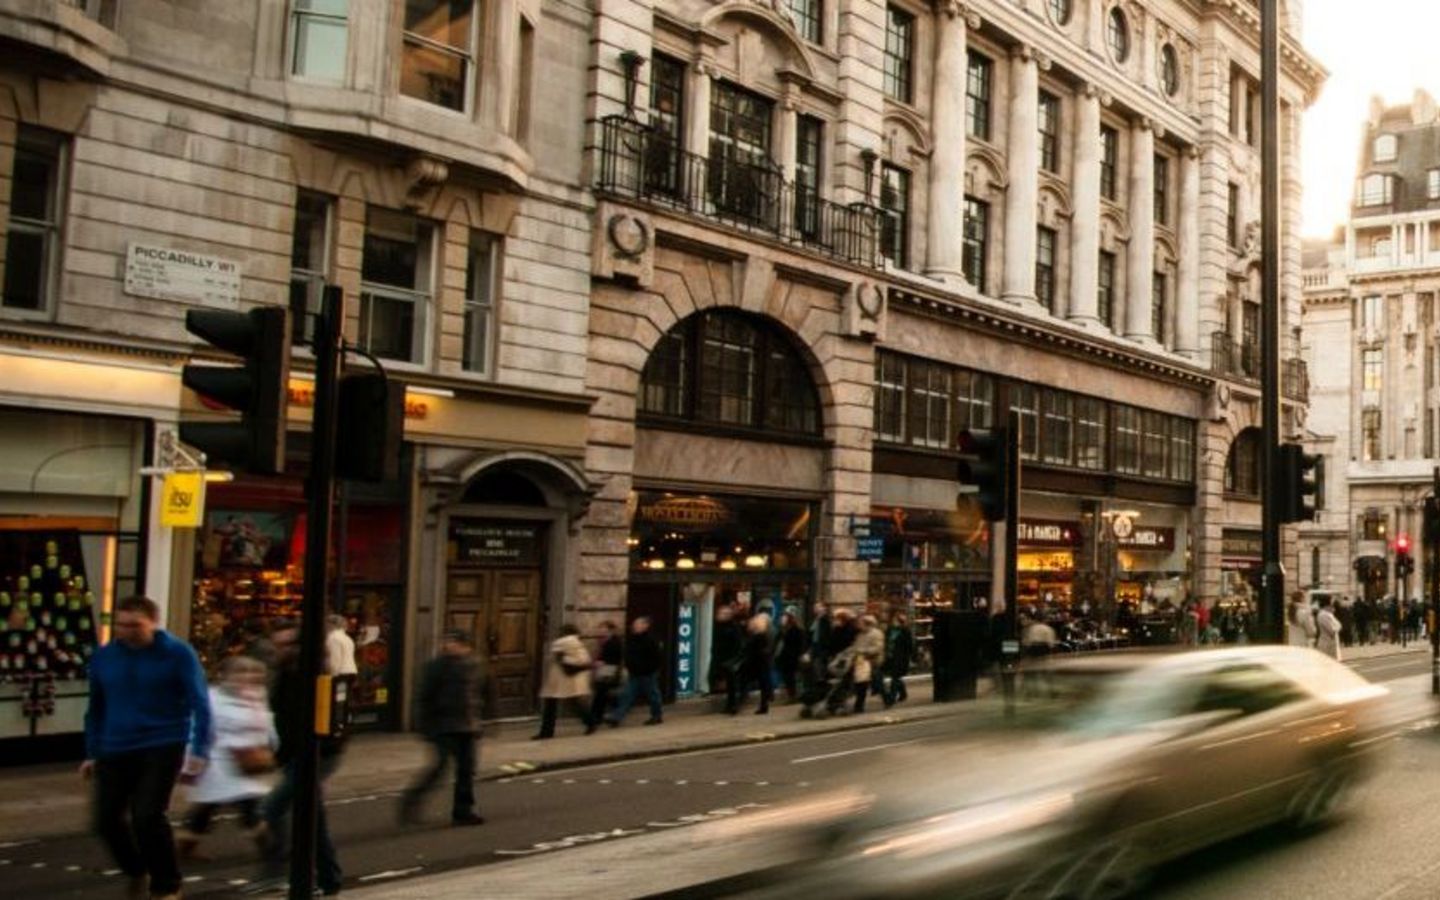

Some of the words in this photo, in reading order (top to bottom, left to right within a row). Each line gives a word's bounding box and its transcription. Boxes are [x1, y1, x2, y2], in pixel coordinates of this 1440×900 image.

[135, 246, 213, 270] PICCADILLY
[217, 261, 236, 273] W1
[677, 605, 692, 690] MONEY
